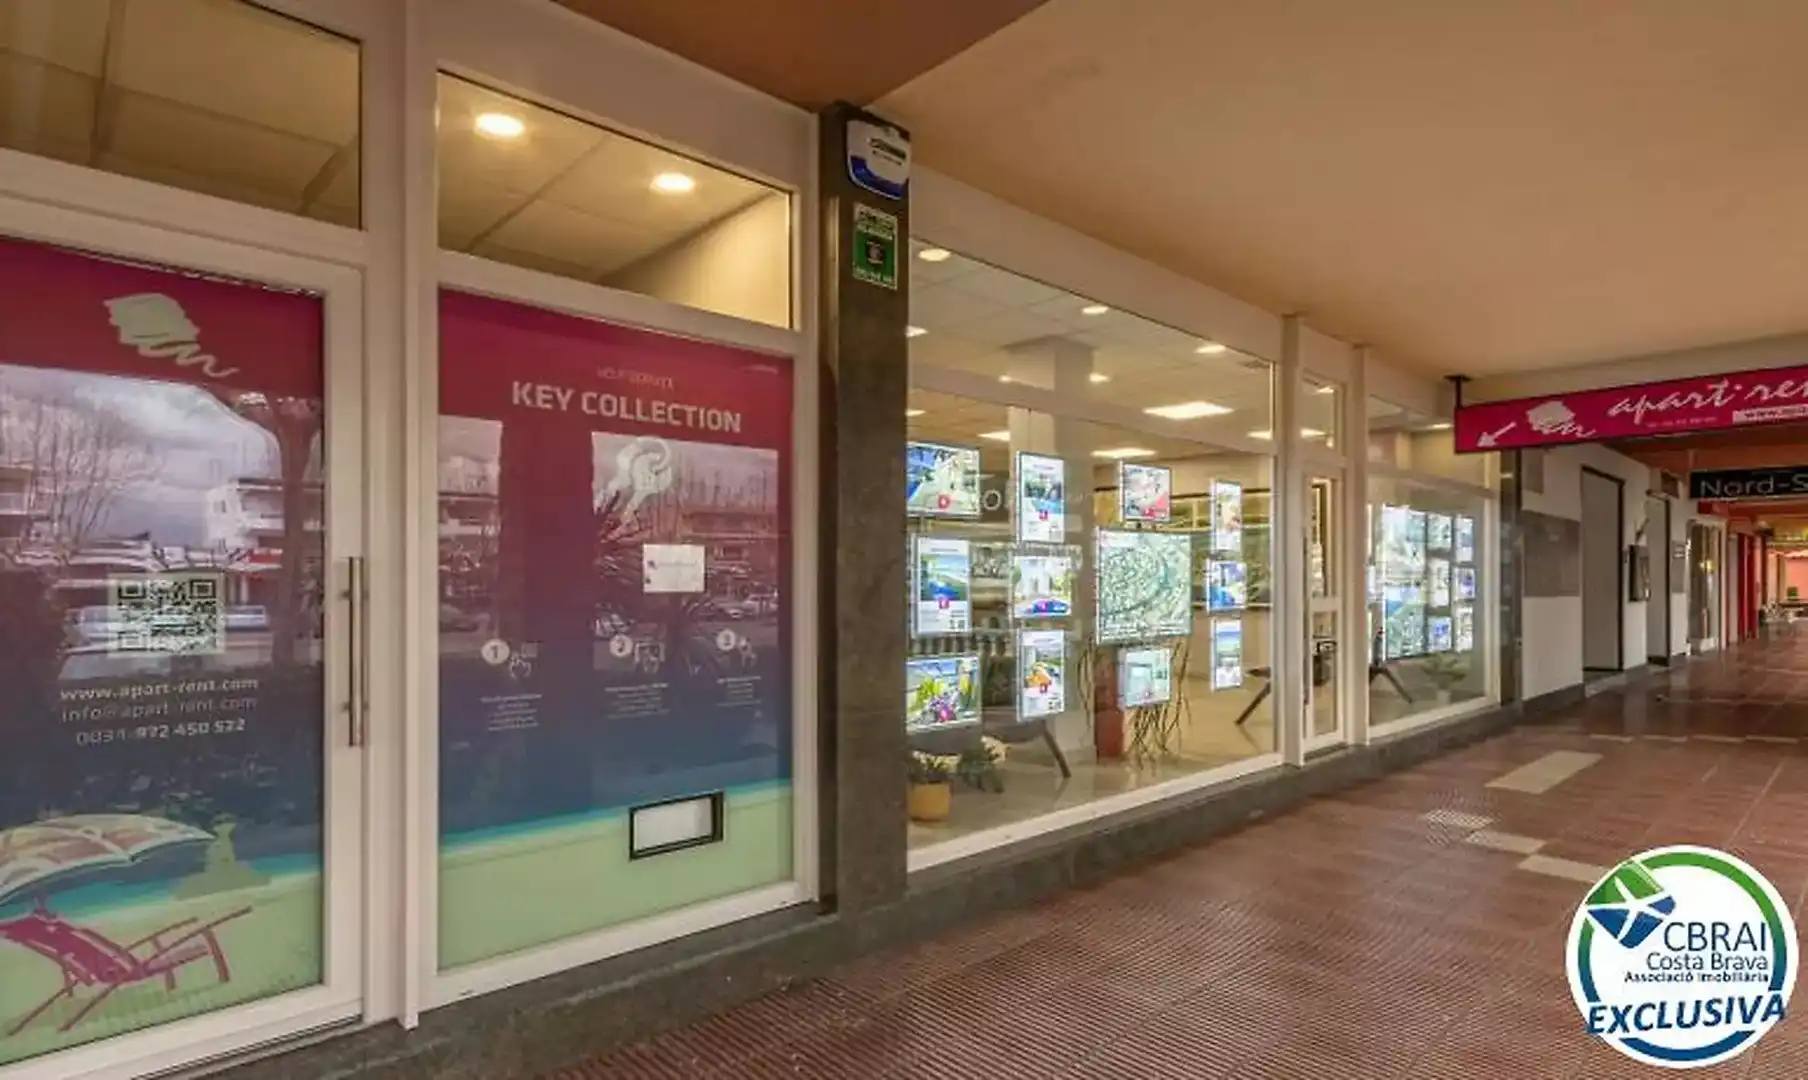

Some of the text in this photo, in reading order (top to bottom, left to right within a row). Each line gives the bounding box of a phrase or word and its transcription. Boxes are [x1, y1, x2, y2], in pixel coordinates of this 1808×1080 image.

[511, 381, 742, 433] KEY COLLECTION
[172, 719, 209, 736] 450
